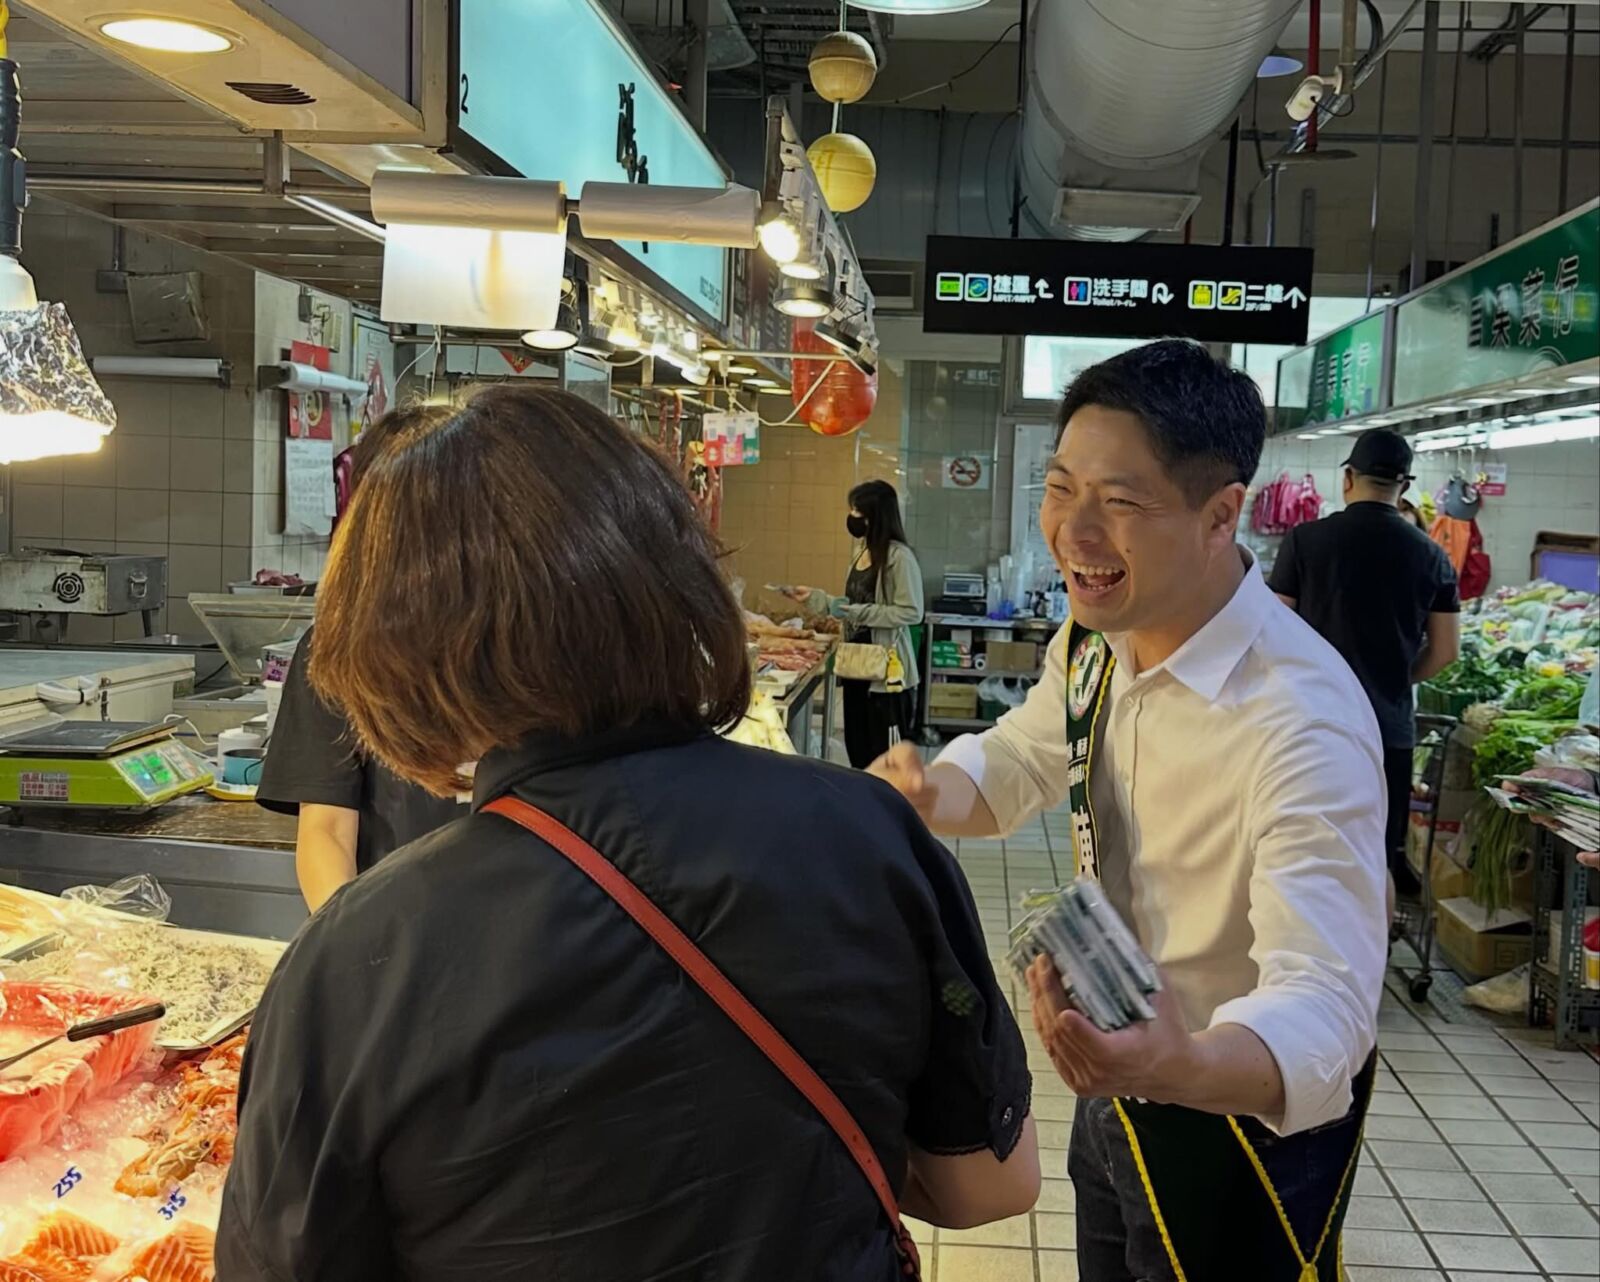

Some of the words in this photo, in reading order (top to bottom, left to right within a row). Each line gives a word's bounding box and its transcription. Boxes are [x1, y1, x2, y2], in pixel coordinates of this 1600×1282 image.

[1092, 278, 1148, 298] 洗手間
[1246, 284, 1285, 303] 二樓
[52, 1166, 82, 1198] 255
